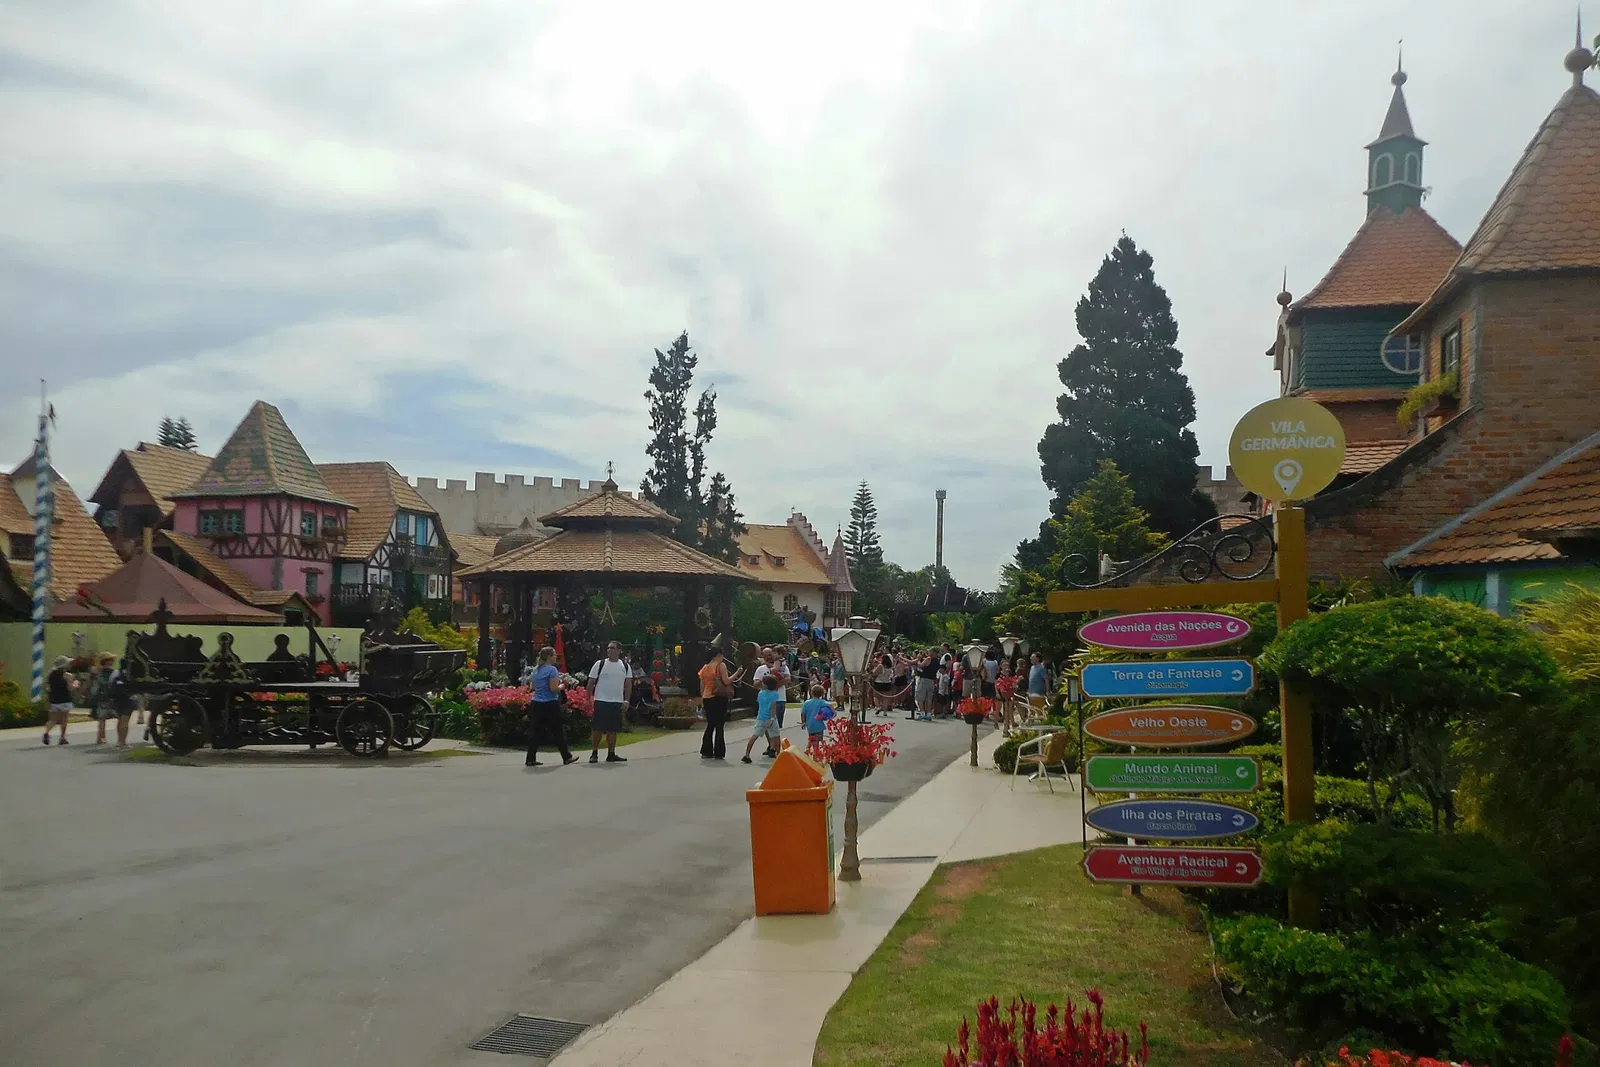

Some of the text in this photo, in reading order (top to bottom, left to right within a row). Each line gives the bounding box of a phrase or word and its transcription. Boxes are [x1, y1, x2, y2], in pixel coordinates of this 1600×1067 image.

[1271, 420, 1306, 434] VILA
[1241, 434, 1336, 451] GERMÂNICA
[1106, 619, 1222, 633] Avenida das Nações
[1112, 668, 1223, 681] Terra da Fantasia
[1128, 716, 1208, 728] Velho Oeste
[1125, 763, 1218, 774] Mundo Animal
[1121, 808, 1222, 821] Ilha dos Piratas
[1118, 854, 1228, 868] Aventura Radical
